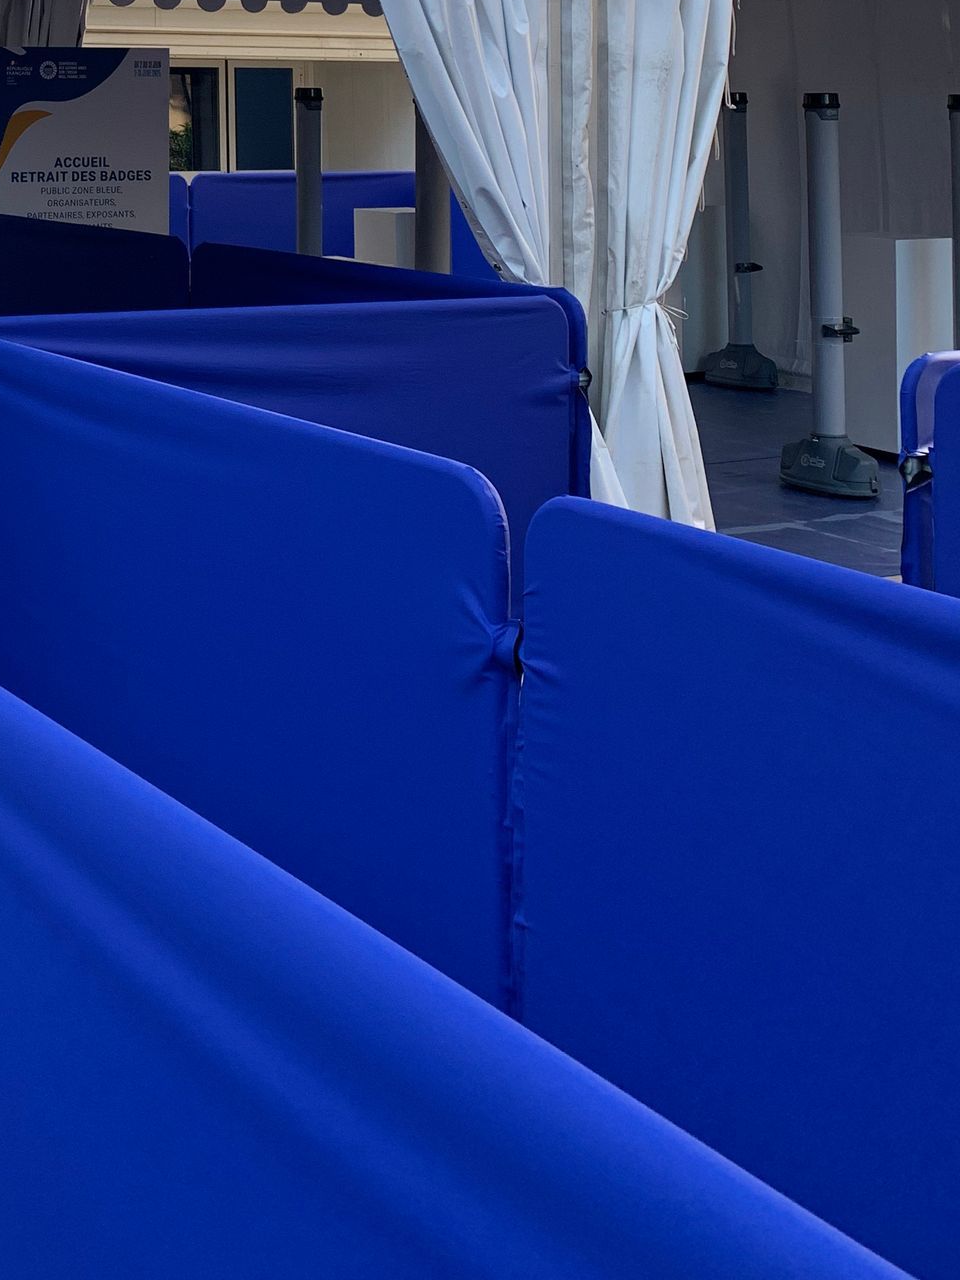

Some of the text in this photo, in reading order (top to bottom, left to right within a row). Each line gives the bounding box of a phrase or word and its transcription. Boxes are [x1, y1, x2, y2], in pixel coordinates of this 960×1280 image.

[54, 156, 110, 168] ACCUEIL
[11, 170, 151, 182] RETRAIT DES BADGES
[40, 186, 70, 195] PUBLIC
[72, 186, 94, 194] ZONE
